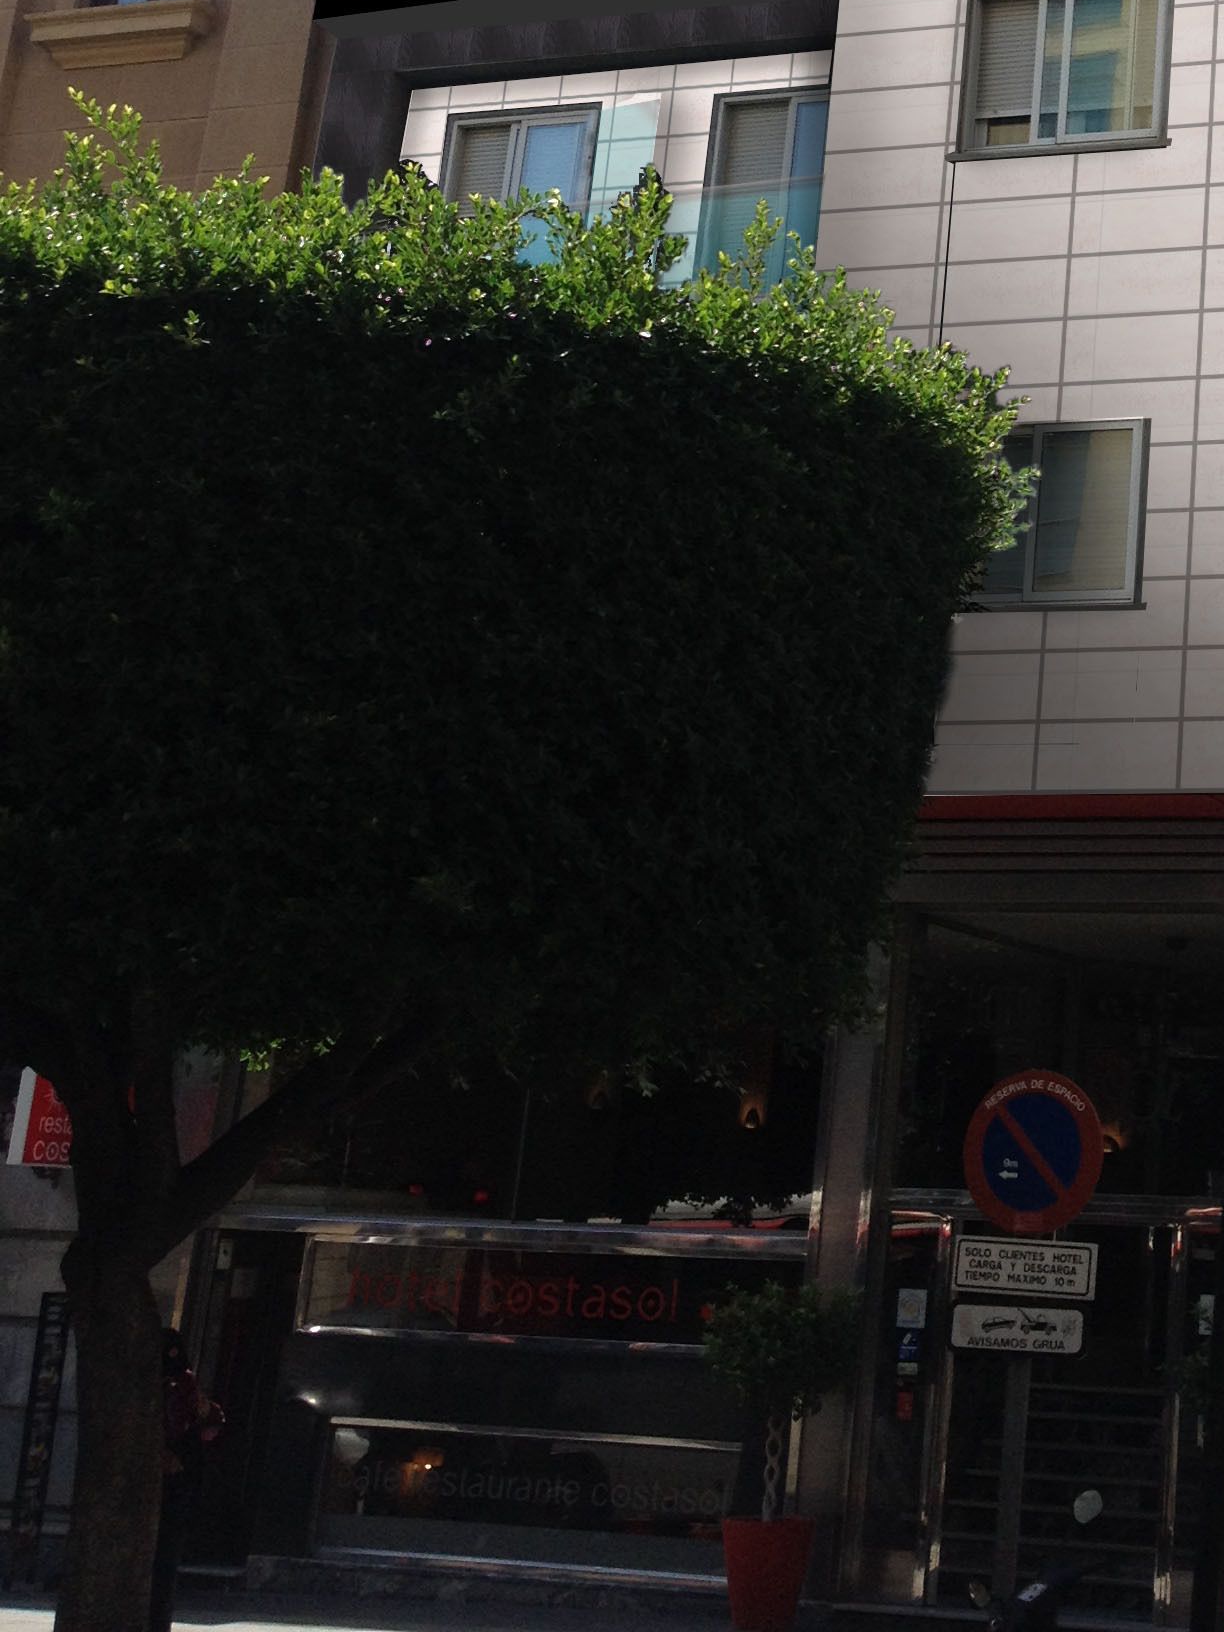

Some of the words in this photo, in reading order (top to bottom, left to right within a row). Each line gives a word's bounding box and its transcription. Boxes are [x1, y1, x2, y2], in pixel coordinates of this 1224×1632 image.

[985, 1081, 1028, 1110] RESERVA
[1031, 1079, 1045, 1089] DE
[1047, 1080, 1086, 1112] ESPACIO
[965, 1247, 992, 1258] SOLO
[999, 1249, 1045, 1262] CLIENTES
[1053, 1253, 1084, 1265] HOTEL
[969, 1258, 1002, 1270] CARGA
[1010, 1262, 1017, 1271] Y
[1023, 1263, 1077, 1276] DESCARGA
[965, 1270, 1000, 1282] TIEMPO
[1007, 1273, 1047, 1286] MAXIMO
[1054, 1276, 1064, 1287] 10
[348, 1264, 463, 1313] hotel
[479, 1272, 681, 1323] costasol
[967, 1336, 1028, 1349] AVISAMOS
[1032, 1339, 1066, 1351] GRUA
